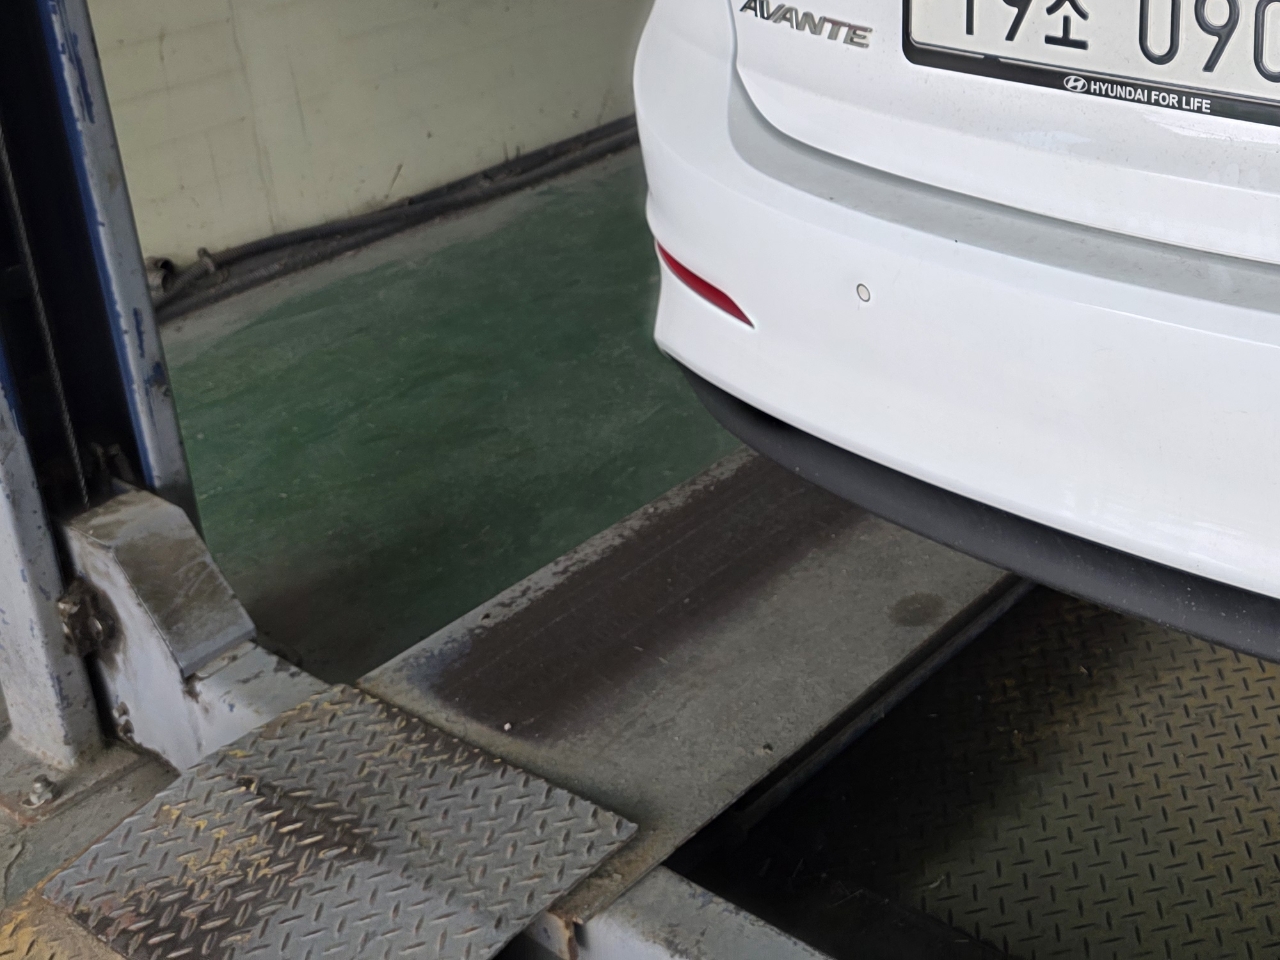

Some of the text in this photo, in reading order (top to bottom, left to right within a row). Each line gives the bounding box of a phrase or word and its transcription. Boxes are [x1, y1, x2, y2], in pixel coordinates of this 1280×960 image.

[1090, 80, 1211, 113] HYUNDAI FOR LIFE
